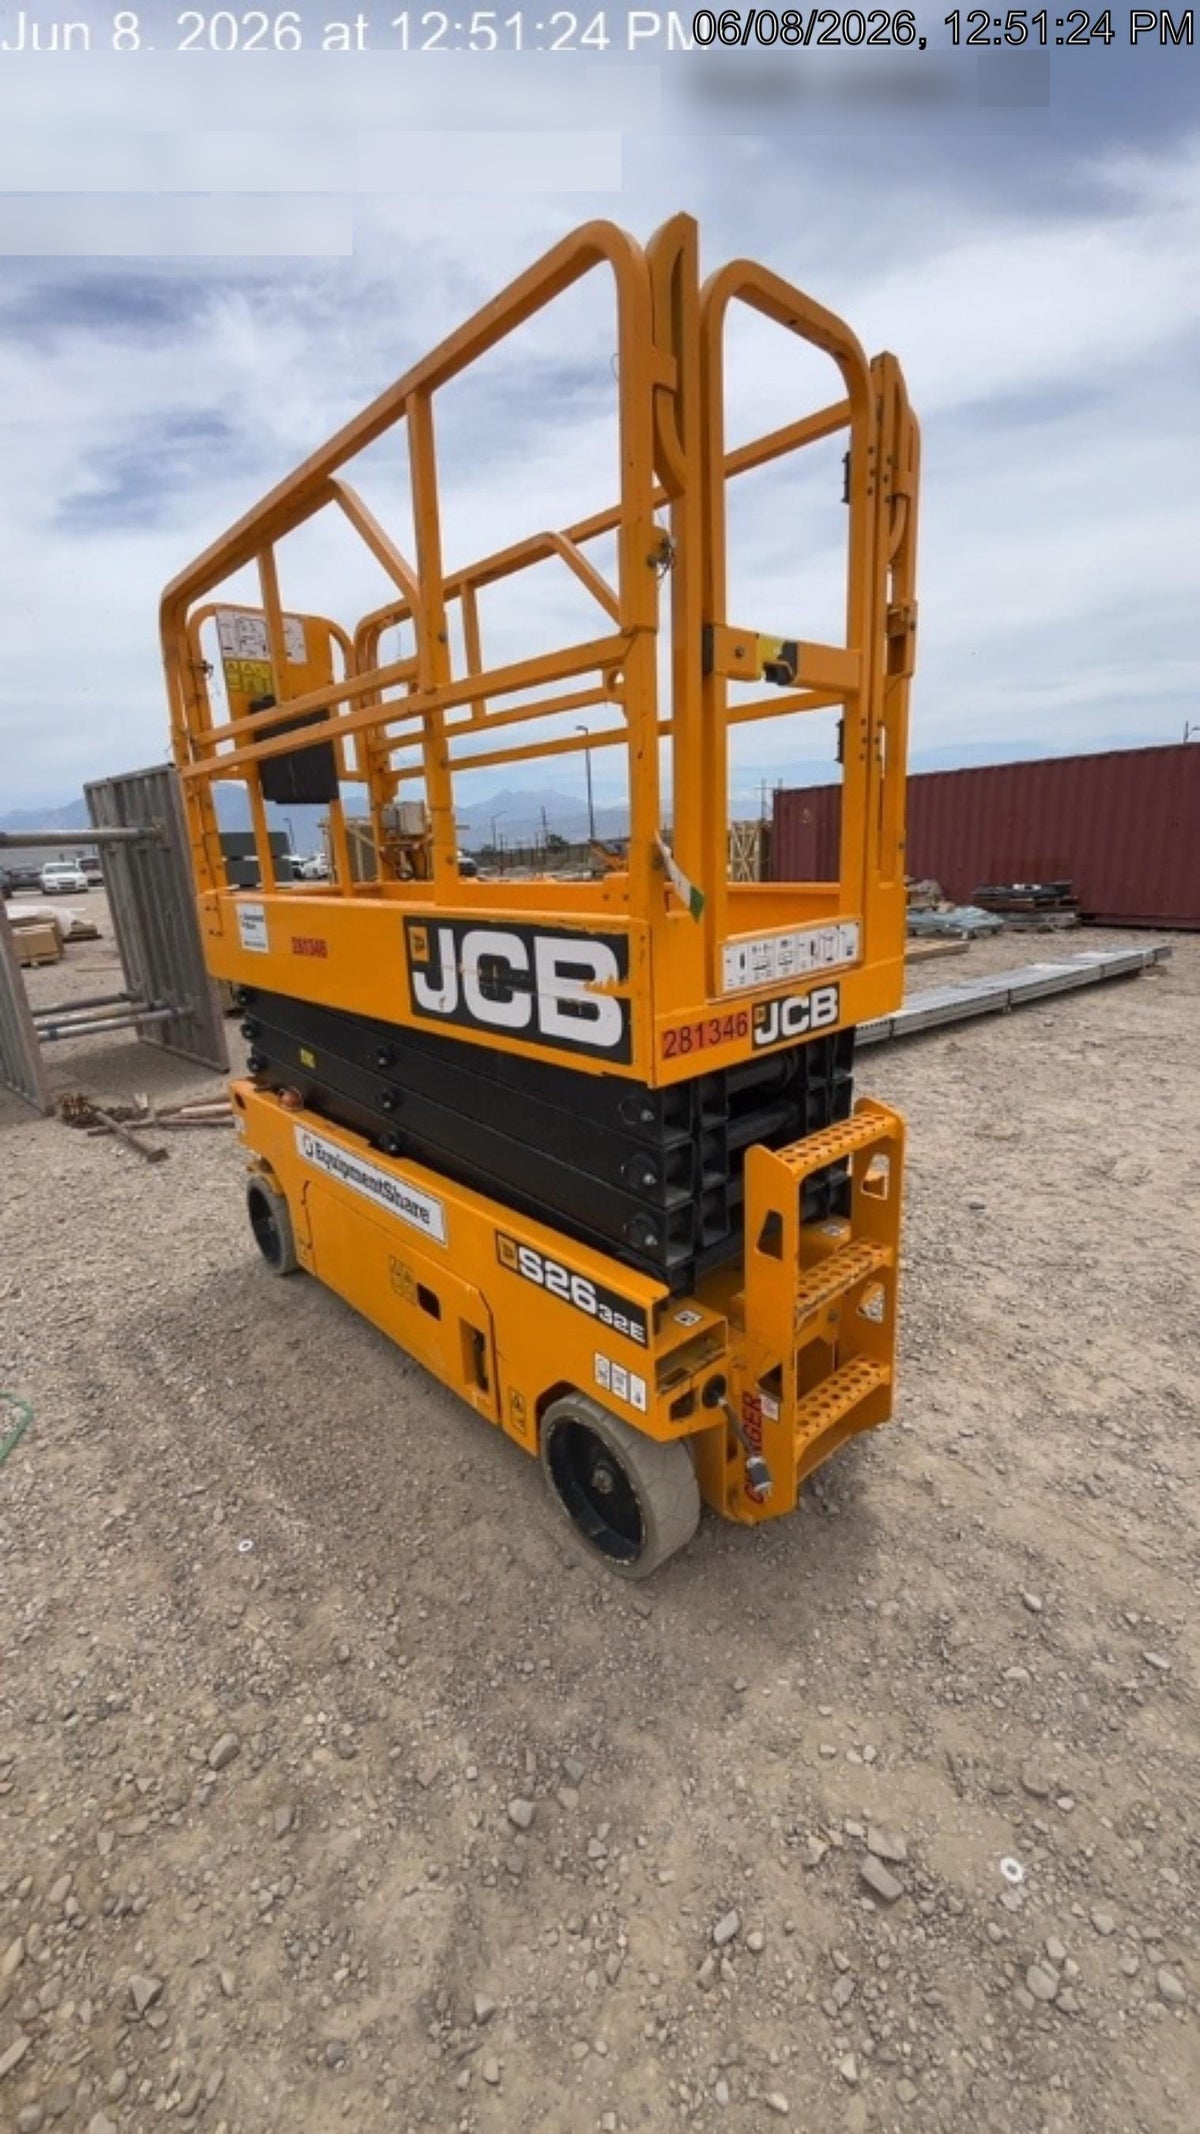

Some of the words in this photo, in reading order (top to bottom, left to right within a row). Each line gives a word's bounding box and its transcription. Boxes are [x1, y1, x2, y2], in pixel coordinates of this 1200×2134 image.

[412, 928, 623, 1047] JCB
[755, 986, 838, 1045] JCB
[663, 1011, 748, 1060] 281346
[314, 1142, 431, 1225] EquipmentShare
